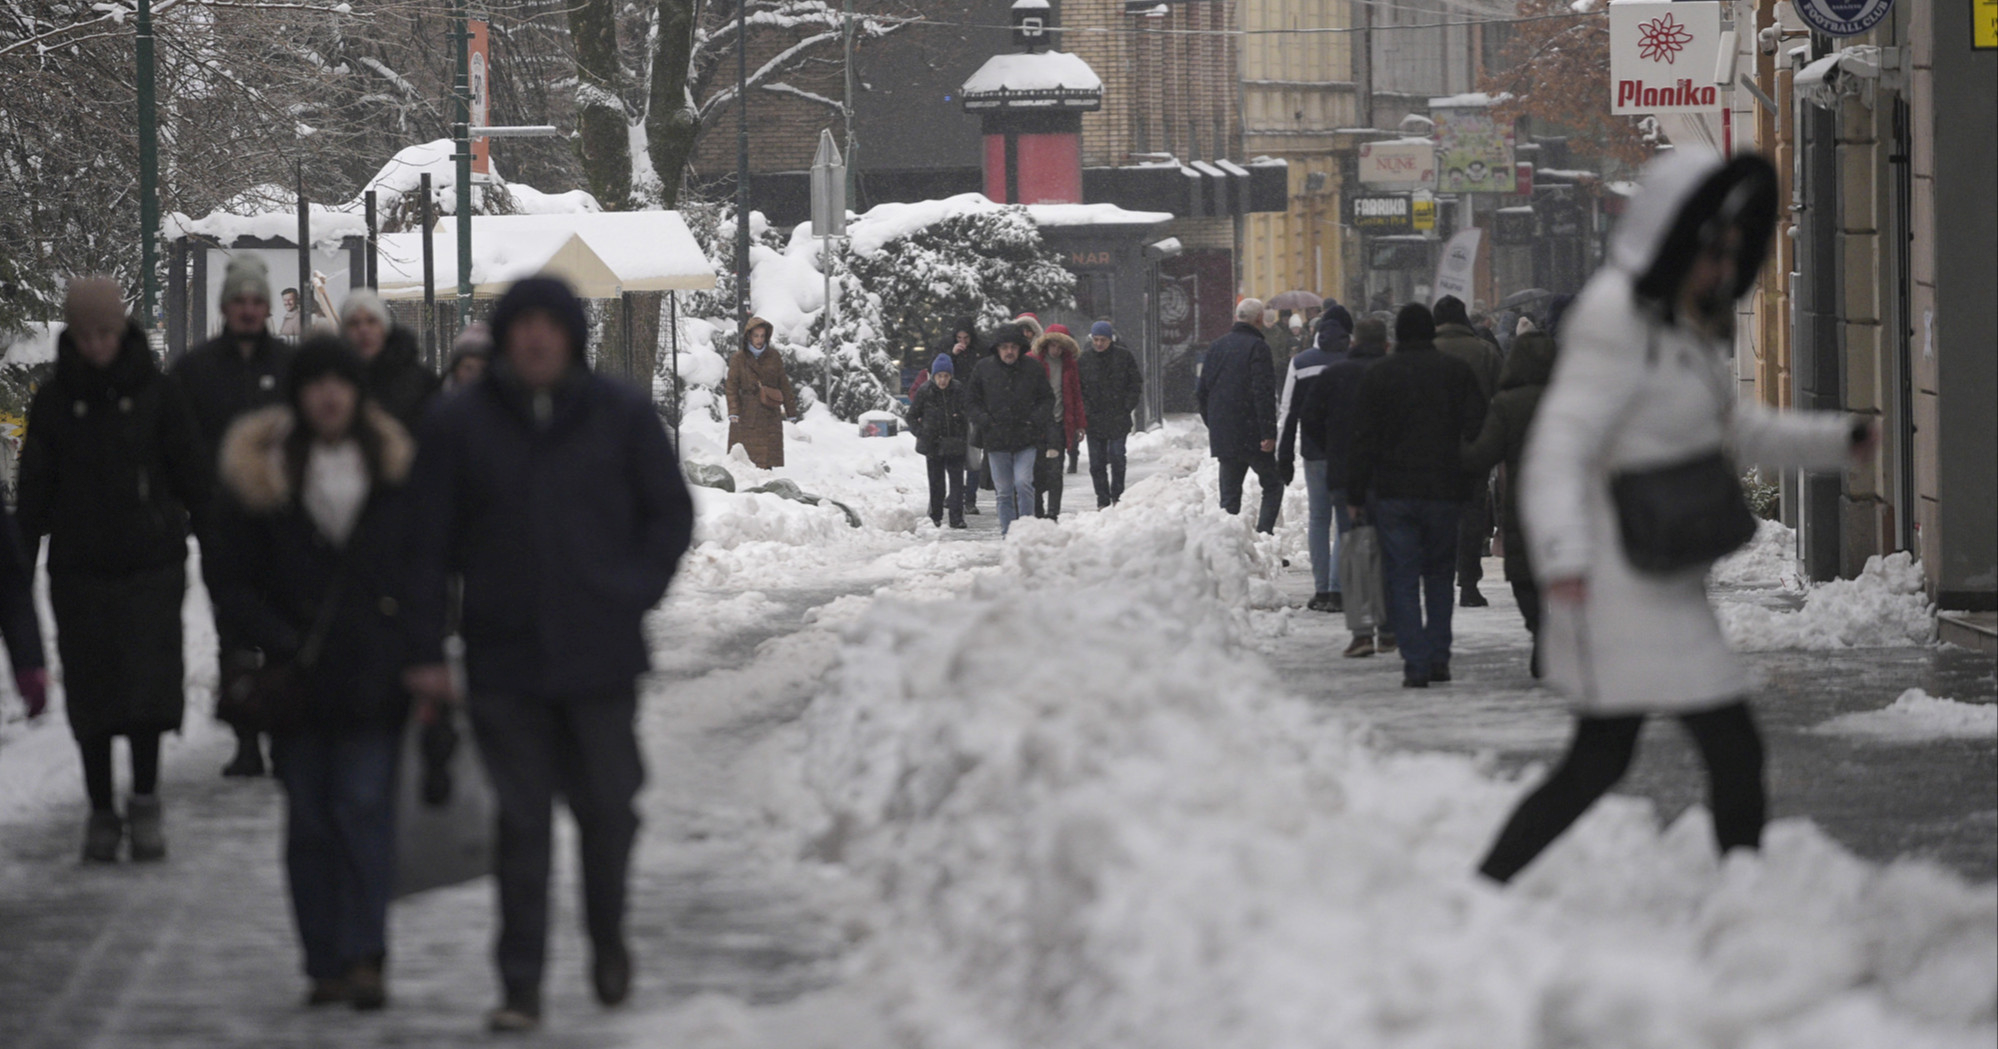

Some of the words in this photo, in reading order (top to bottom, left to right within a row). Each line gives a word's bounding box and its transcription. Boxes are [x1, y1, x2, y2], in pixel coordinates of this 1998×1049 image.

[1803, 2, 1862, 33] FOOTBALL
[1862, 1, 1889, 27] CLUB
[1617, 79, 1716, 107] Planika
[1376, 157, 1416, 170] NUNE
[1354, 198, 1407, 216] FABRIKA
